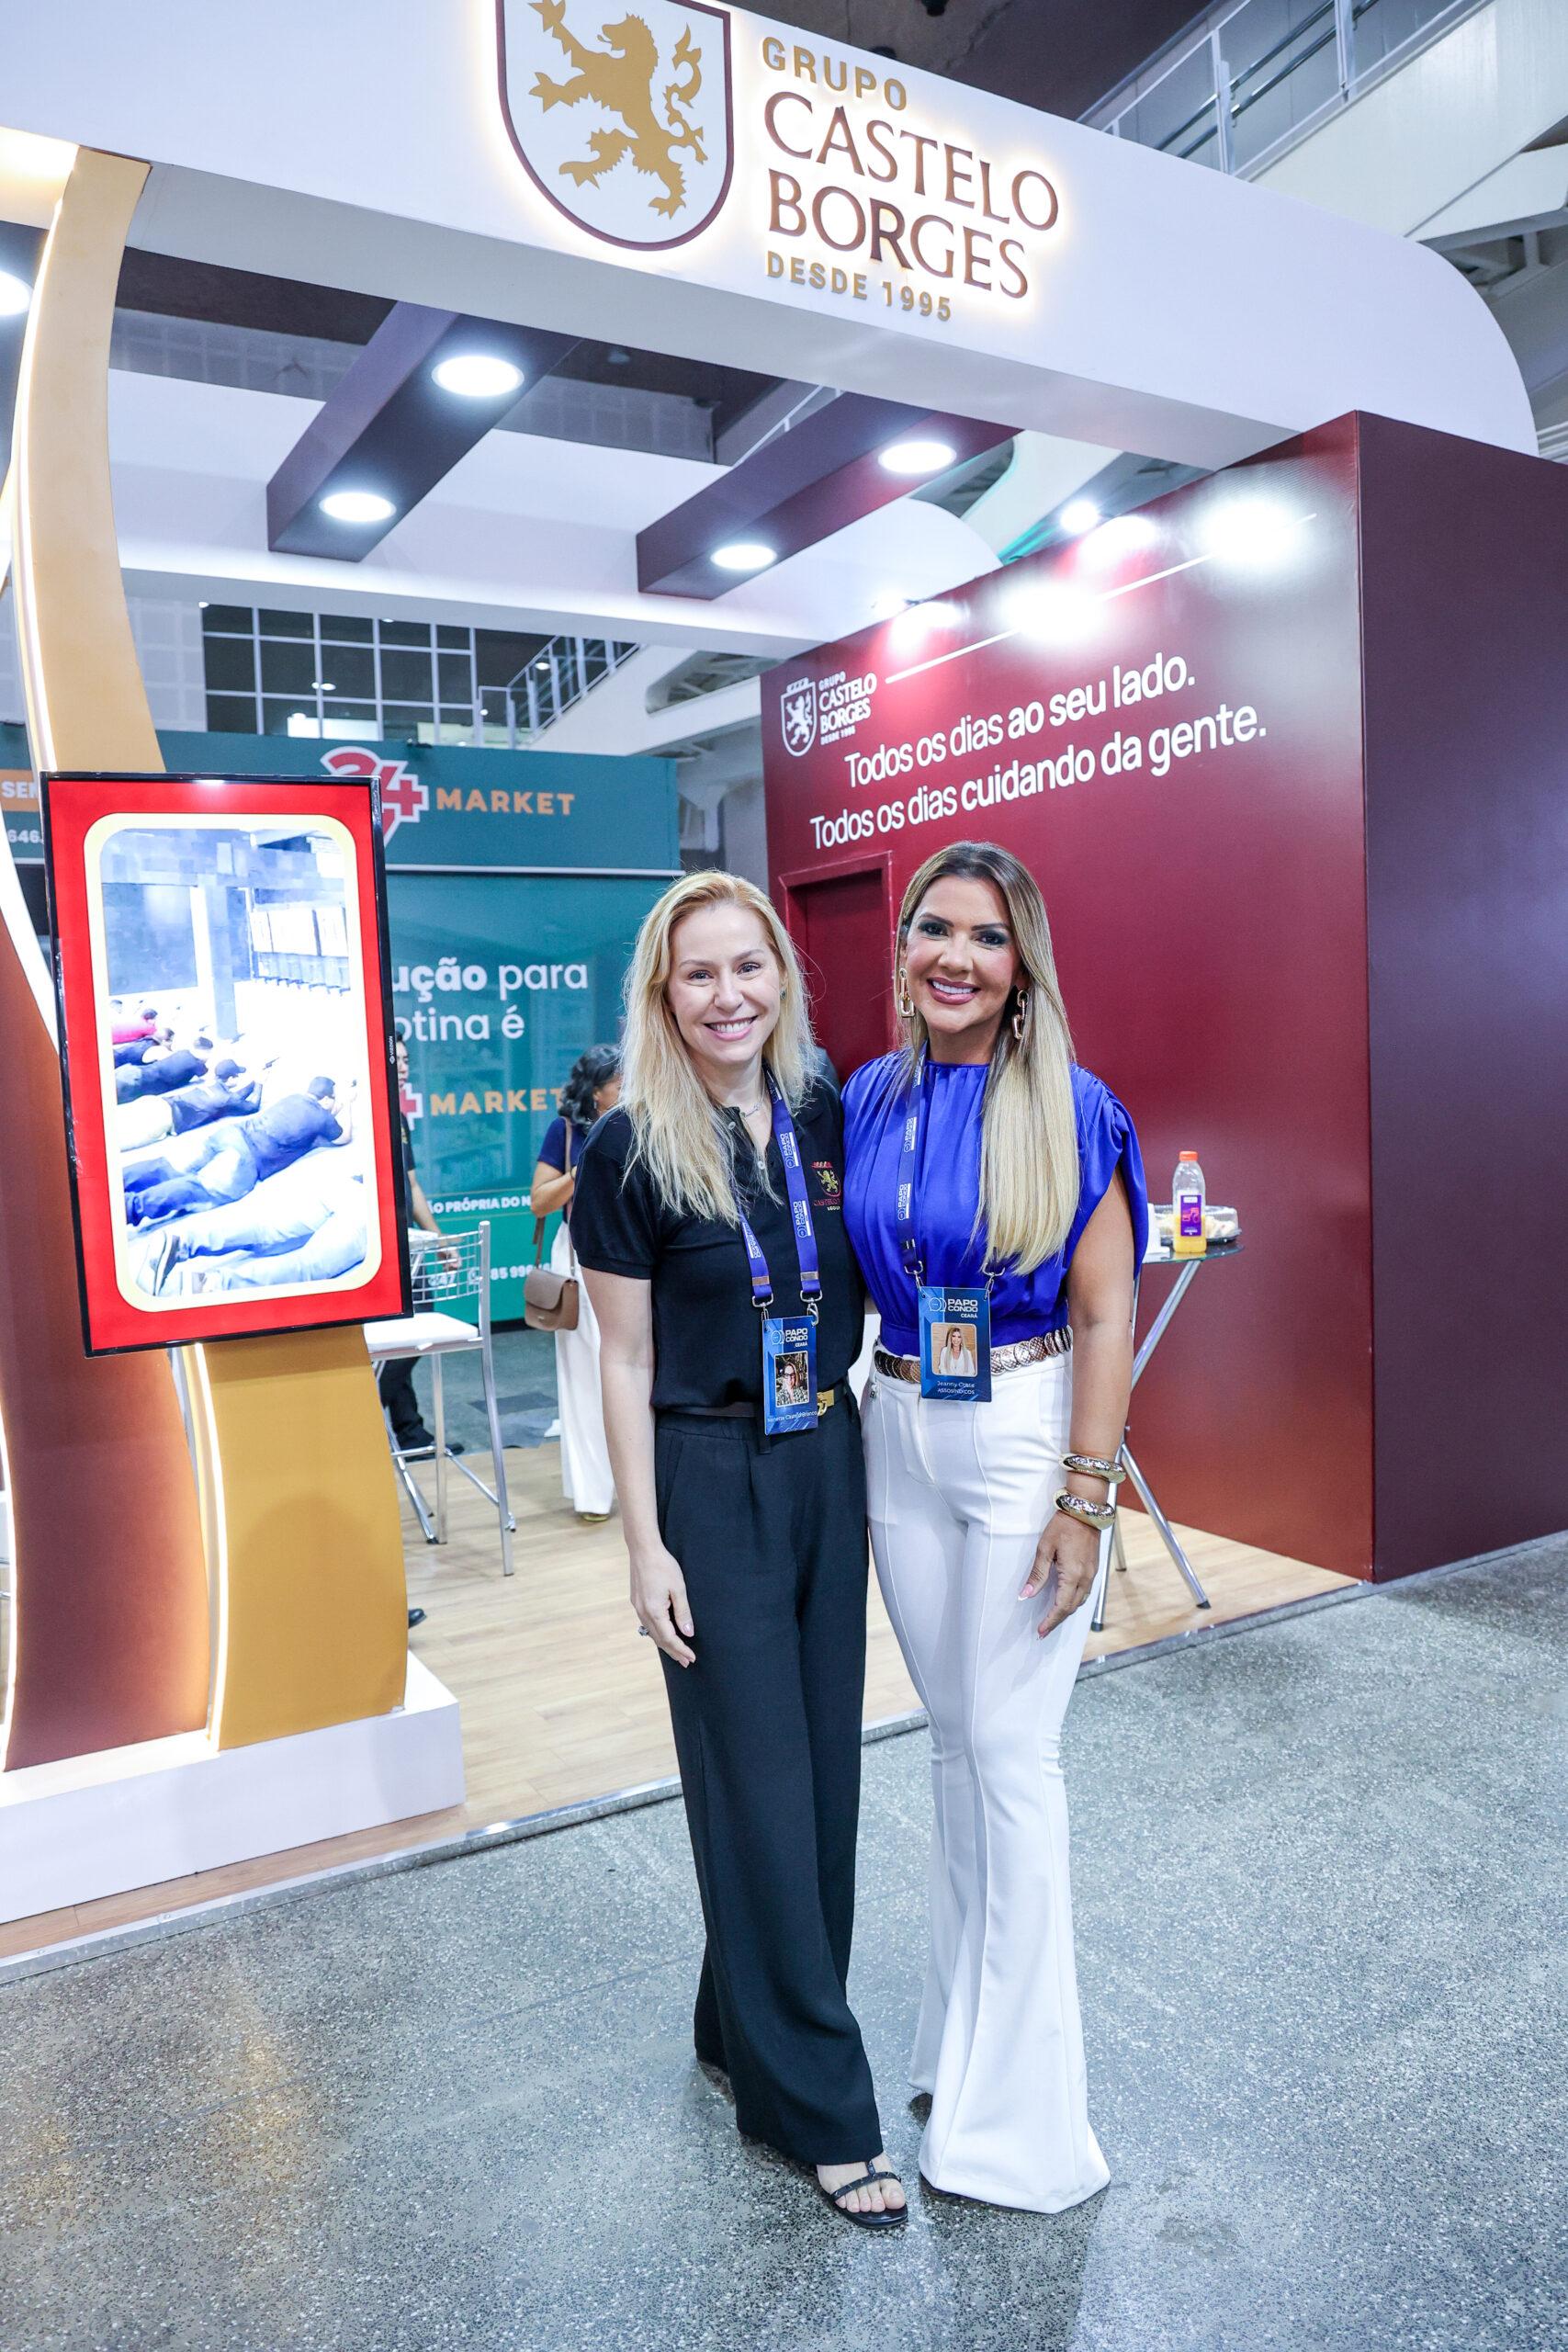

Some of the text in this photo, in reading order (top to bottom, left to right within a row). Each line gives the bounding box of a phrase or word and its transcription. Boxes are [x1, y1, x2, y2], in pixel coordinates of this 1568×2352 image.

[761, 36, 908, 112] GRUPO
[764, 91, 1059, 232] CASTELO
[768, 169, 1029, 300] BORGES
[767, 251, 952, 322] DESDE 1995
[818, 671, 846, 691] GRUPO
[819, 673, 877, 711] CASTELO
[820, 697, 871, 734] BORGES
[844, 651, 1196, 787] Todos os dias ao seu lado.
[810, 702, 1268, 850] Todos os dias cuidando da gente.
[436, 787, 575, 816] MARKET
[499, 964, 588, 1001] para
[502, 1005, 525, 1039] é
[780, 1133, 788, 1156] PAPO
[446, 1197, 500, 1213] PRÓPRIA
[501, 1196, 521, 1208] DO
[793, 1201, 801, 1226] PAPO
[491, 1268, 509, 1281] 85
[947, 1298, 978, 1307] PAPO
[785, 1328, 808, 1336] PAPO
